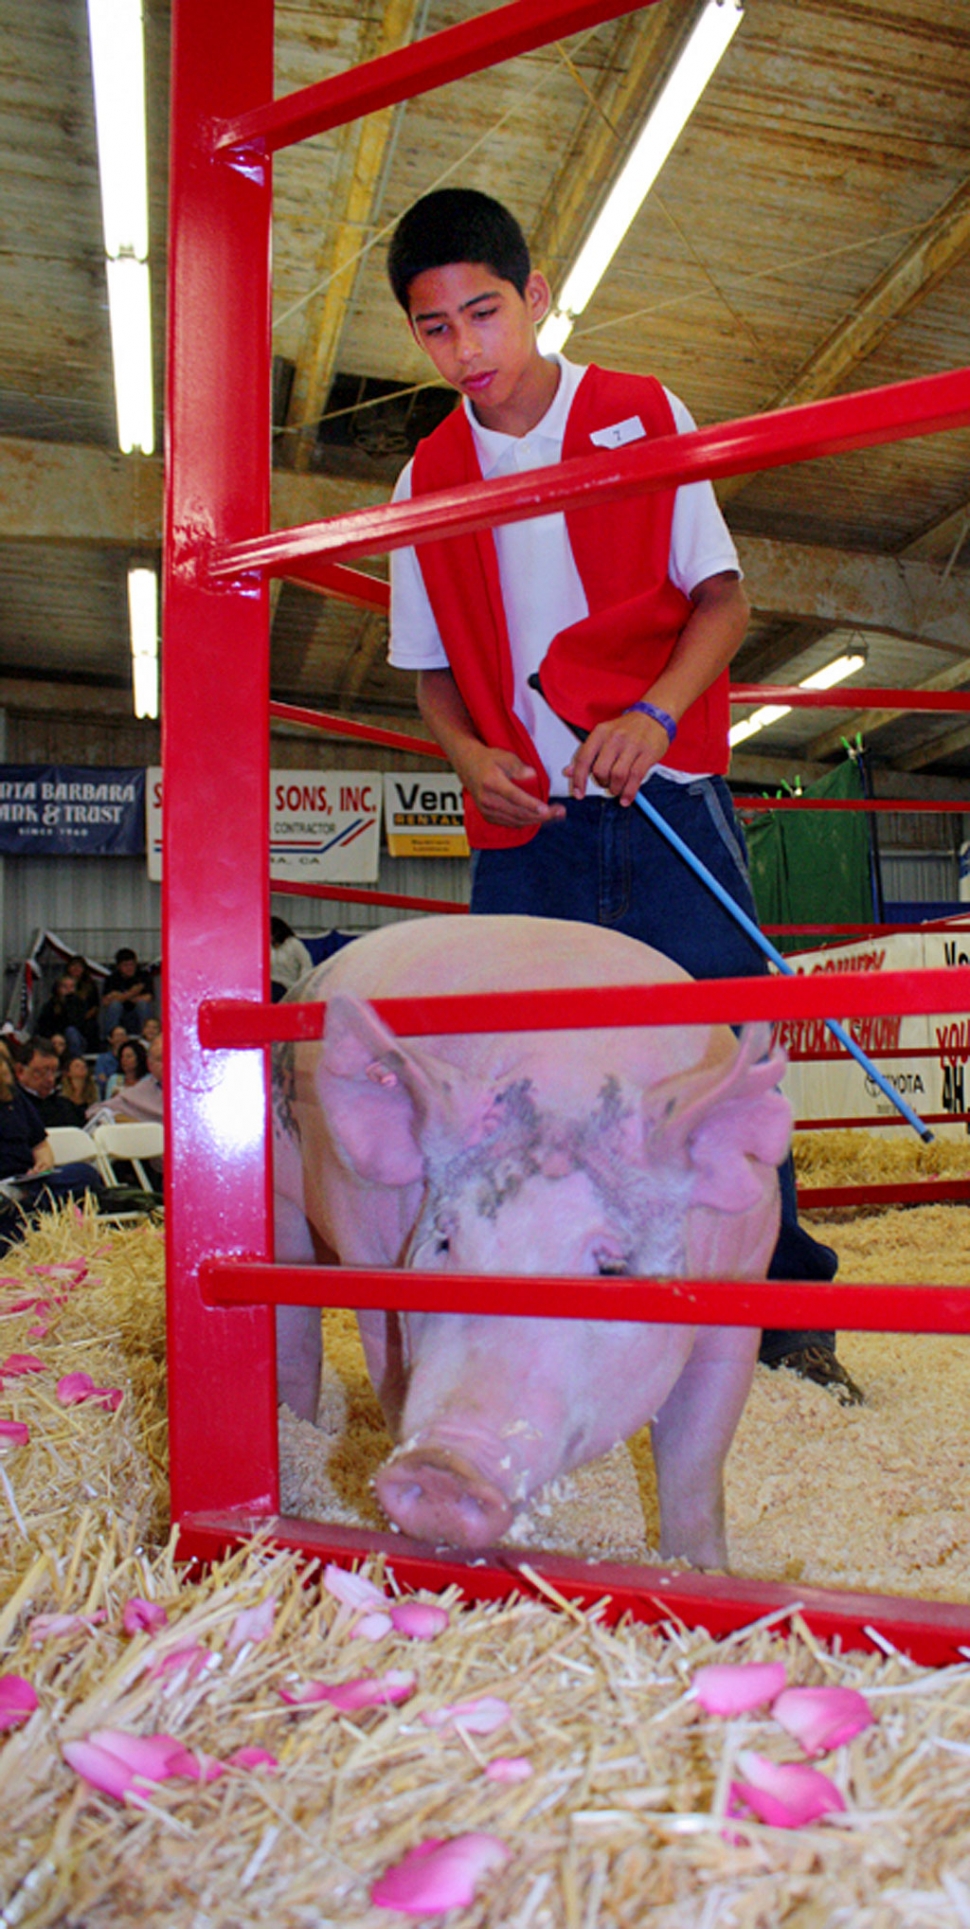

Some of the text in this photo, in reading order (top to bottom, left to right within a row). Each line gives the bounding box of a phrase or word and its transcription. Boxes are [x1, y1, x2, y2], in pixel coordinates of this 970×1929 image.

[41, 782, 136, 802] BARBARA
[275, 784, 377, 816] SONS, INC.
[395, 783, 464, 812] Ven
[42, 803, 60, 826] &
[64, 804, 124, 824] TRUST
[274, 821, 337, 836] CONTRACTOR
[299, 856, 320, 866] CA
[936, 1018, 970, 1071] YOU
[882, 1073, 926, 1095] YOTA
